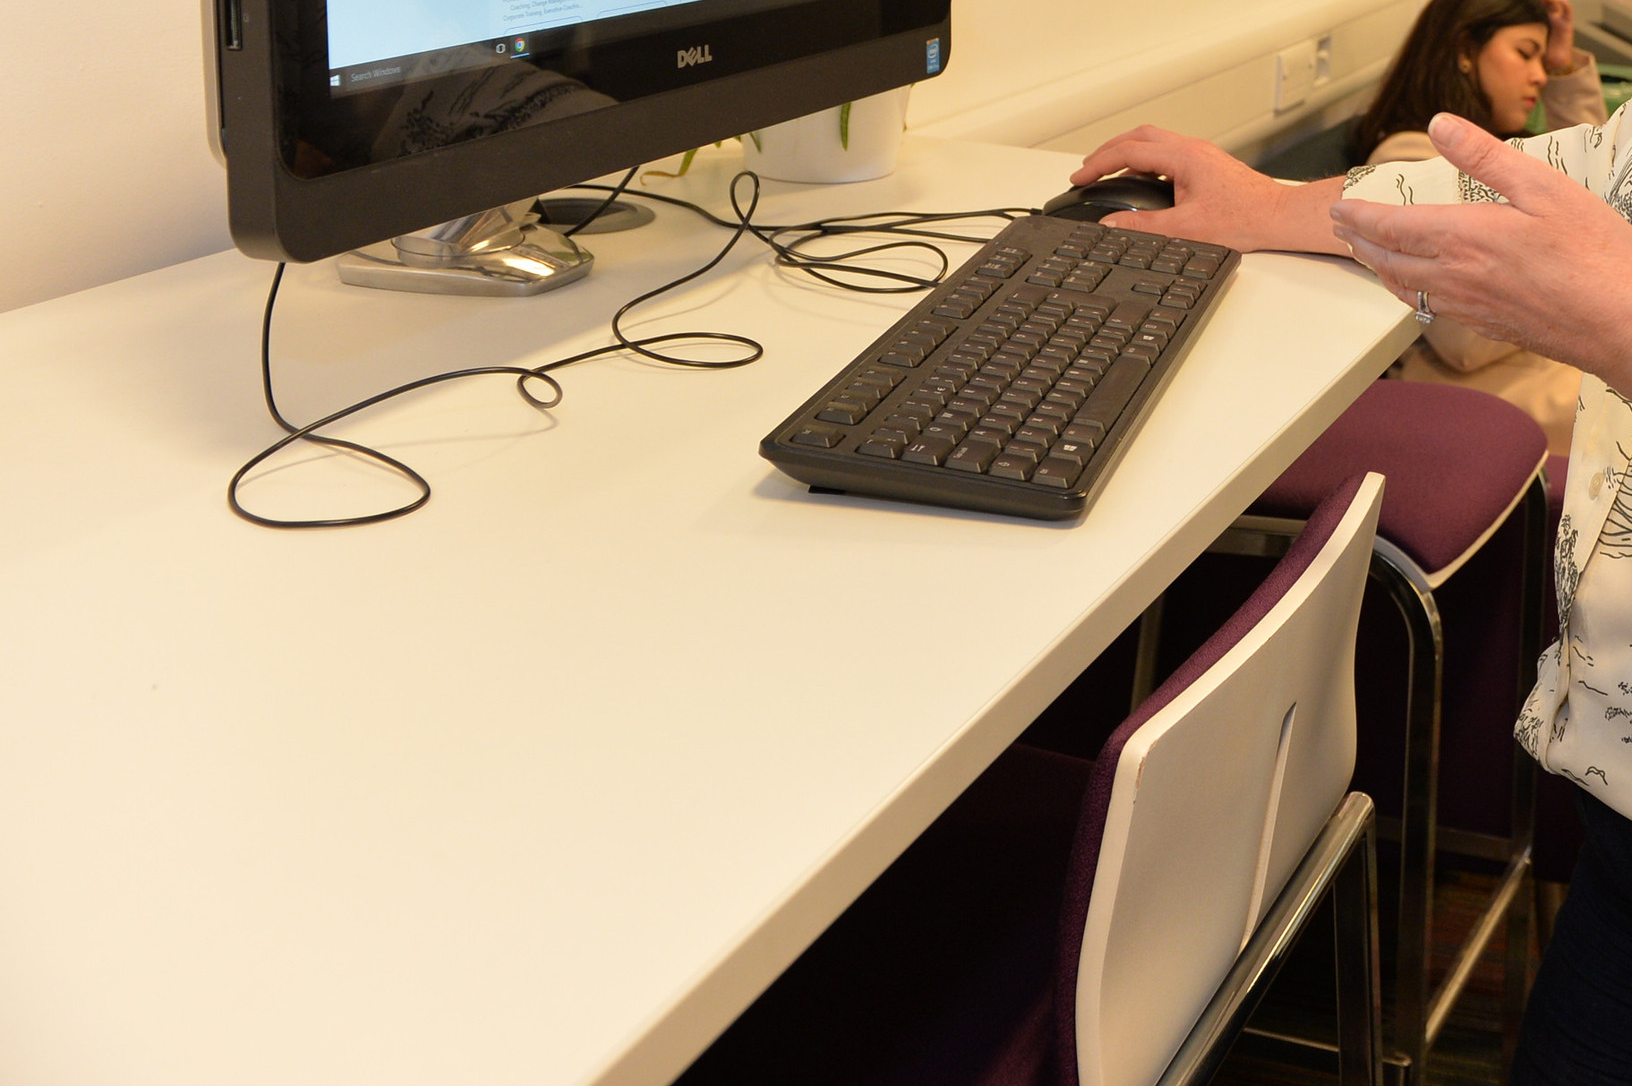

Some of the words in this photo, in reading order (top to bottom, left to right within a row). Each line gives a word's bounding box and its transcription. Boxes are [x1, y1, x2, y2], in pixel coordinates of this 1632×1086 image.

[677, 44, 712, 68] DELL
[350, 71, 371, 83] Search
[372, 64, 401, 78] Windows
